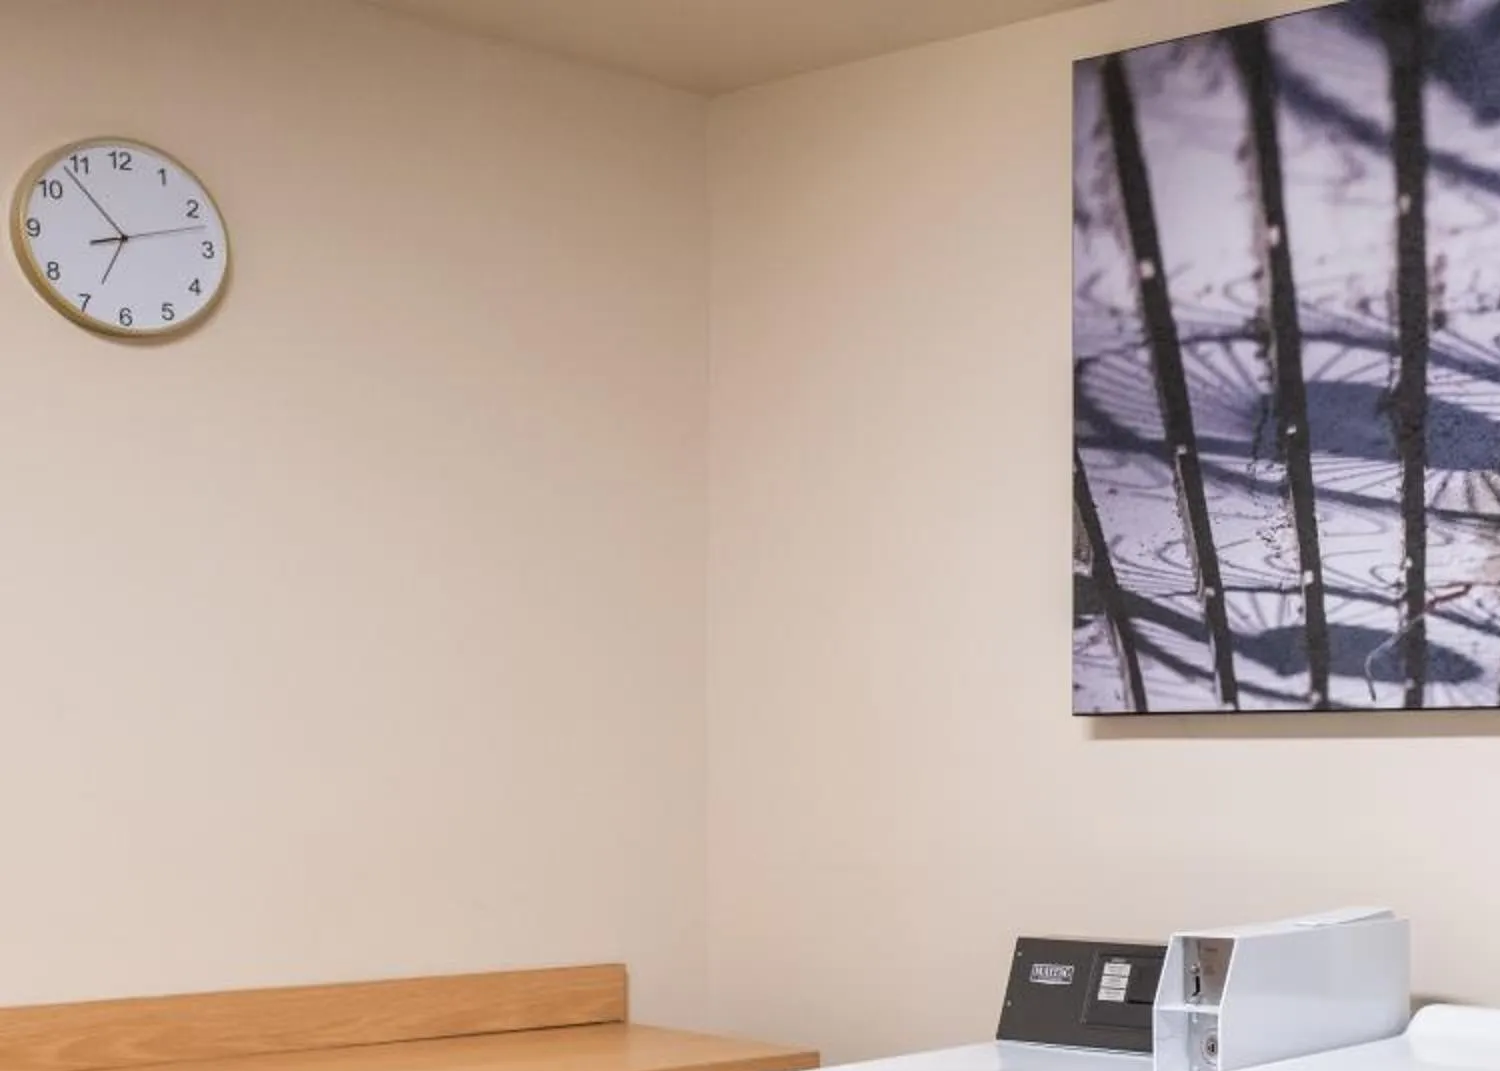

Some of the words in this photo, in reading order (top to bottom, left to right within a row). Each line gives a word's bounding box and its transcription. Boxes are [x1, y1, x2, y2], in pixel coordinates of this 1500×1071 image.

[70, 155, 90, 174] 11
[108, 151, 132, 171] 12
[158, 168, 167, 186] 1
[39, 180, 63, 199] 10
[186, 200, 200, 219] 2
[26, 218, 41, 237] 9
[202, 241, 215, 259] 3
[47, 261, 61, 280] 8
[188, 278, 202, 296] 4
[78, 293, 92, 312] 7
[161, 303, 175, 321] 5
[119, 308, 133, 326] 6
